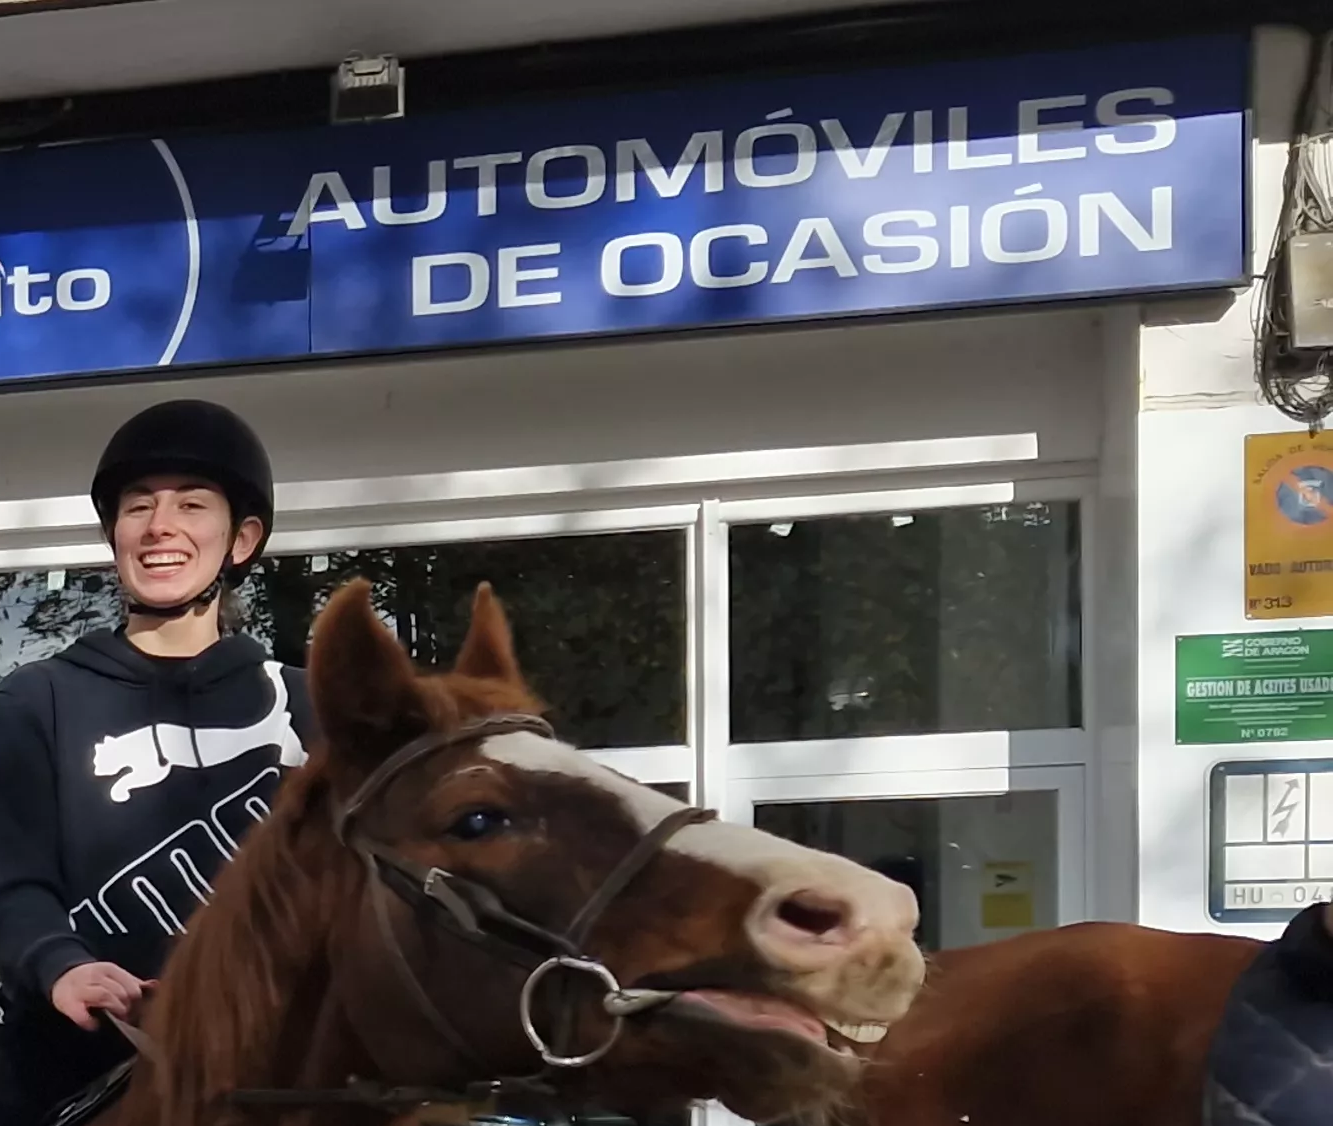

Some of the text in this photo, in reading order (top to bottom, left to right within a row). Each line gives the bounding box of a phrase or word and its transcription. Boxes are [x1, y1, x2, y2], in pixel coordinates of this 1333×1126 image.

[286, 87, 1177, 237] AUTOMÓVILES
[411, 183, 1173, 317] DE OCASIÓN
[1186, 680, 1234, 697] GESTION
[1237, 679, 1251, 696] DE
[1254, 678, 1297, 696] ACEITES
[1233, 886, 1264, 905] HU
